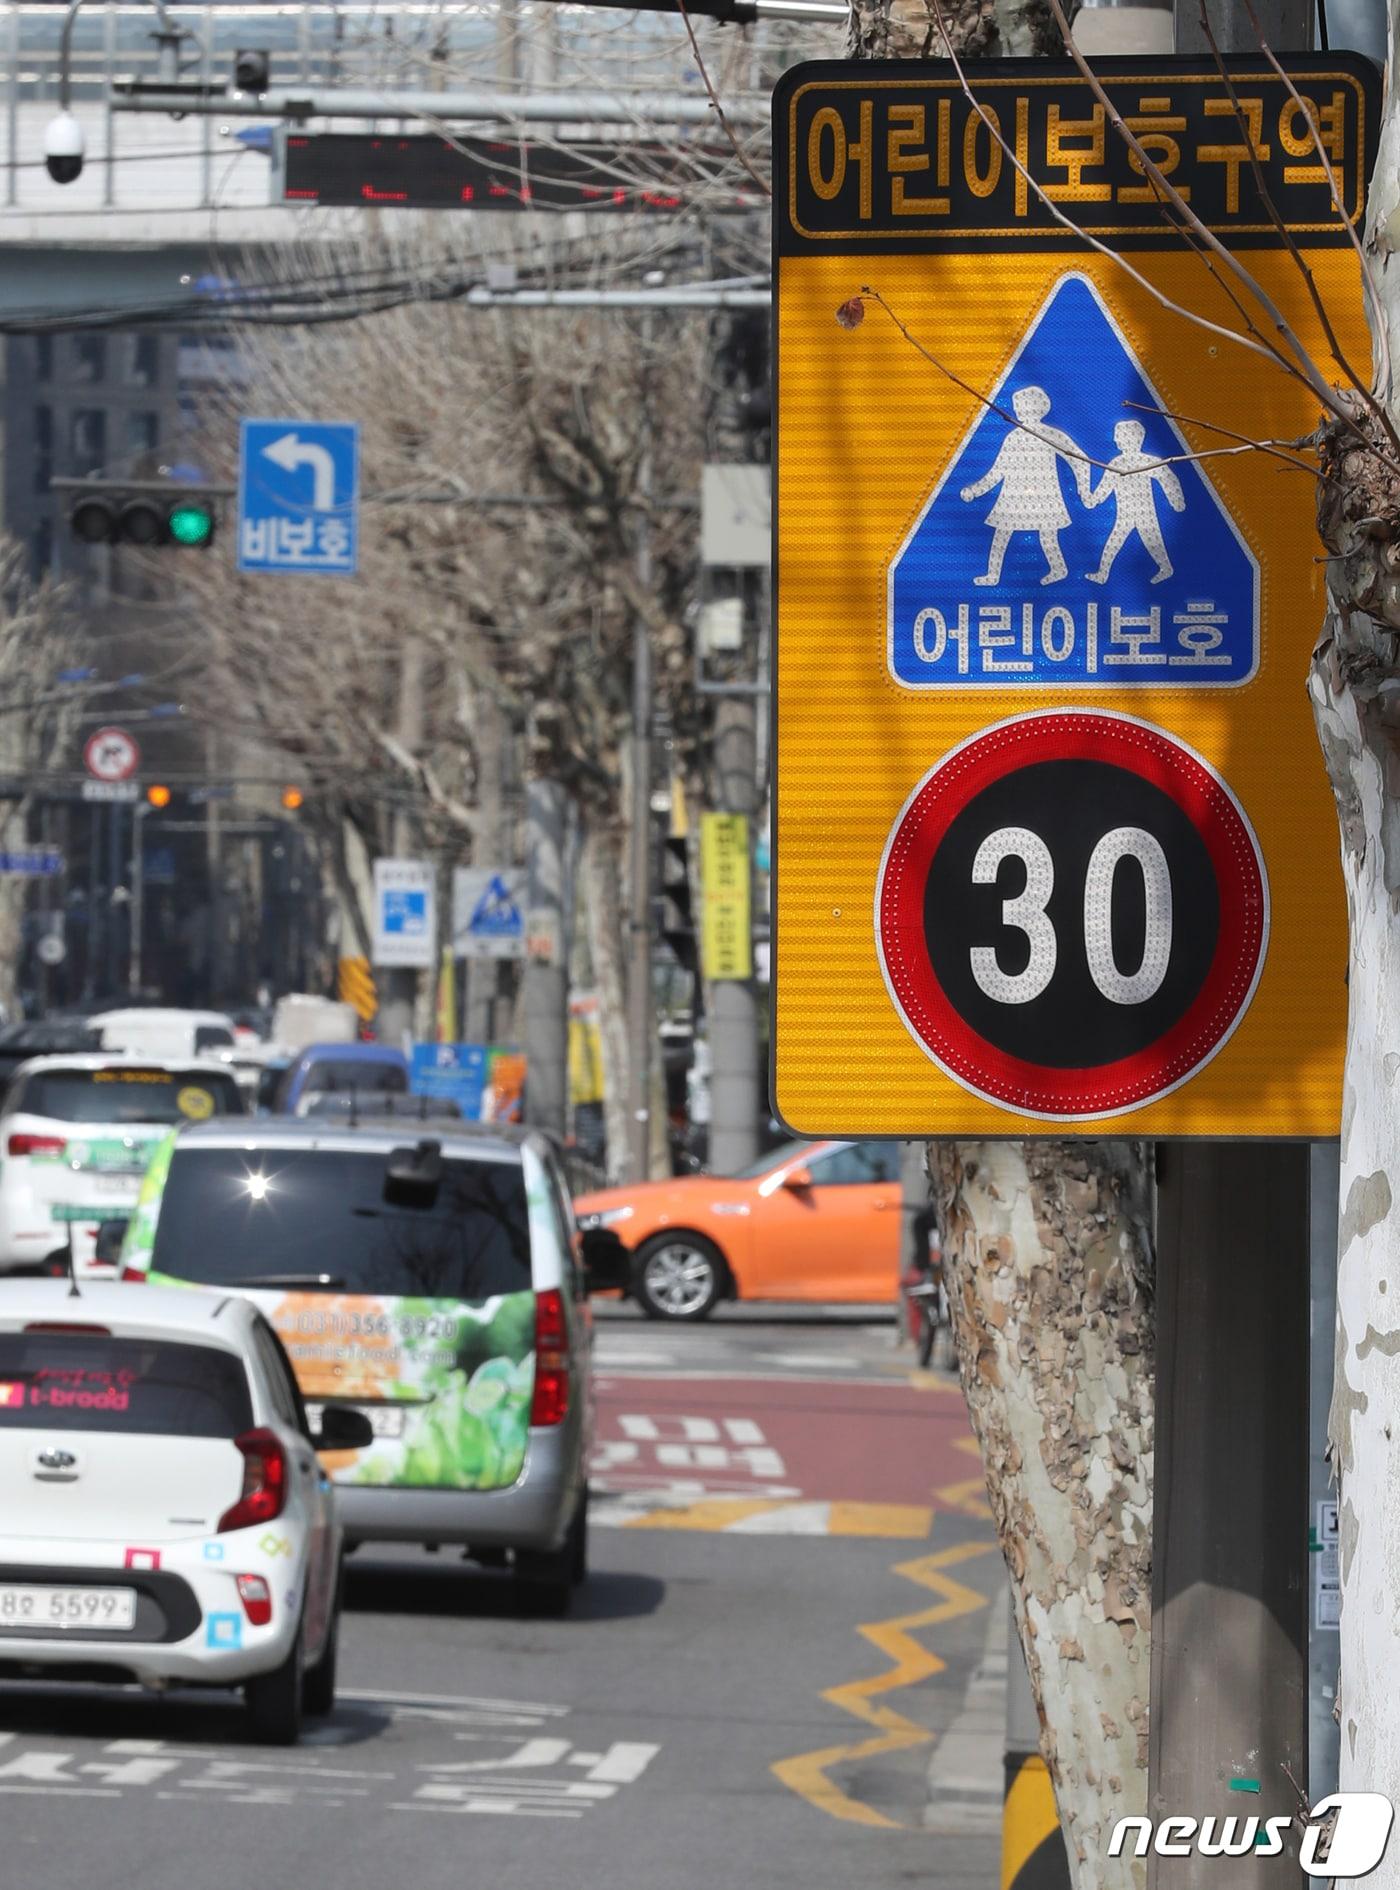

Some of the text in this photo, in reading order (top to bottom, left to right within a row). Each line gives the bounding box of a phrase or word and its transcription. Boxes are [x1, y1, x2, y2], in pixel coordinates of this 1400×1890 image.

[807, 90, 1345, 220] 어린이보호구역
[240, 515, 351, 566] 비보호
[912, 599, 1233, 674] 어린이보호
[969, 826, 1174, 1006] 30
[49, 1593, 118, 1619] 5599
